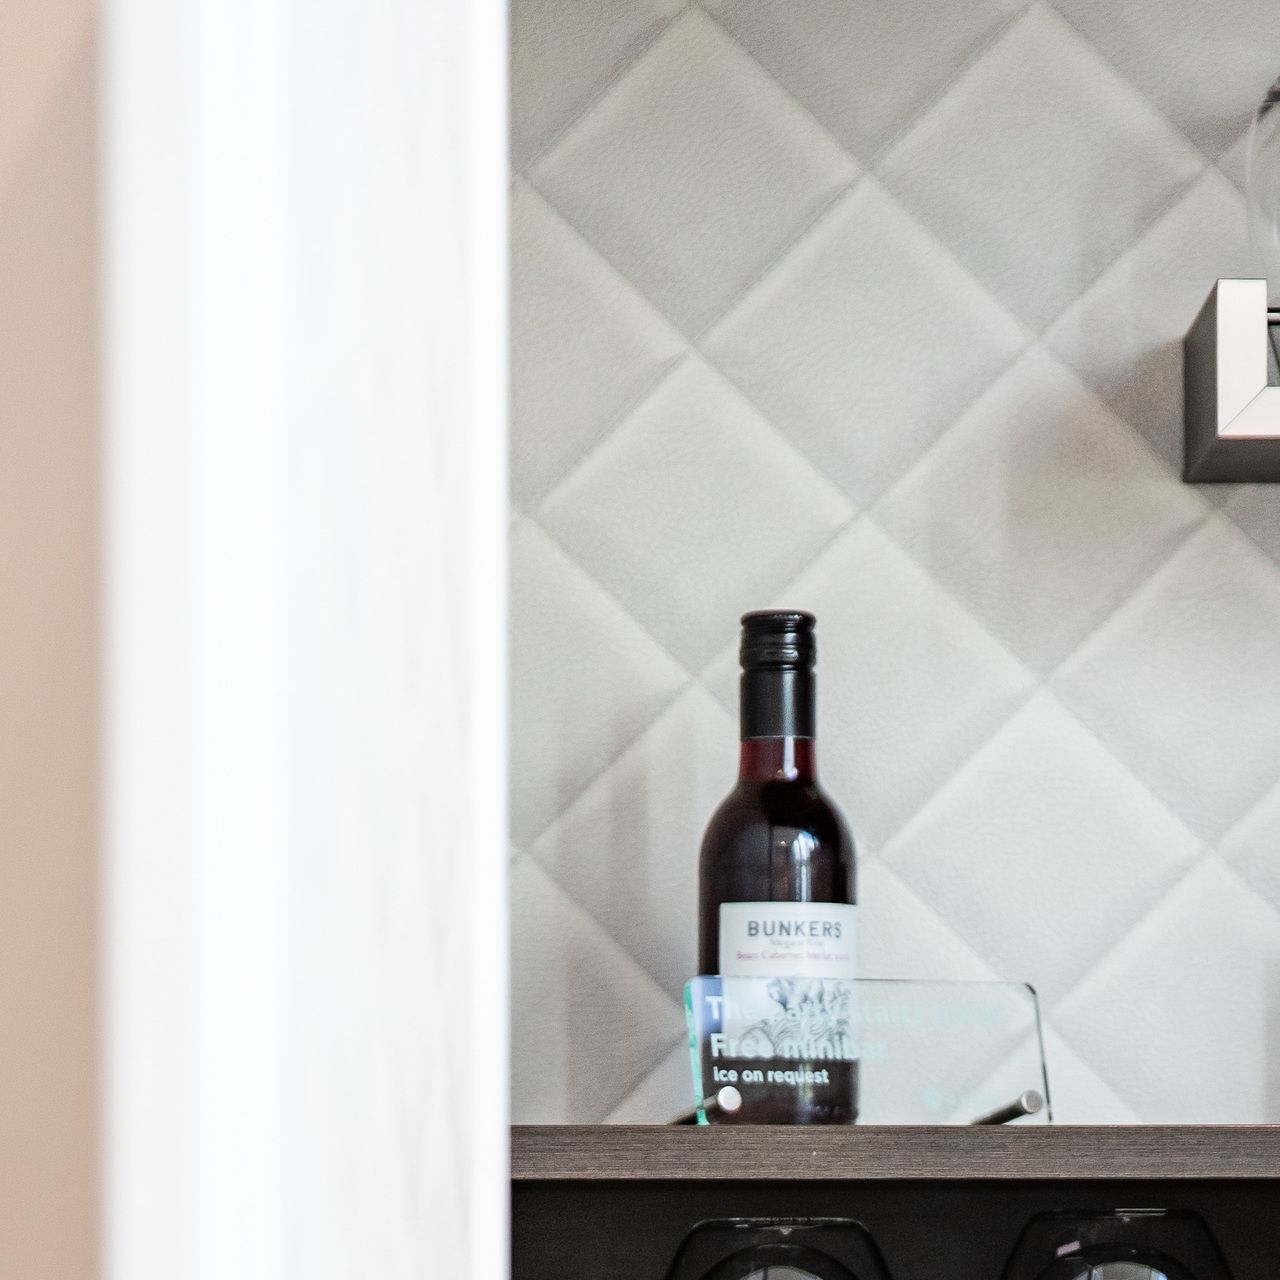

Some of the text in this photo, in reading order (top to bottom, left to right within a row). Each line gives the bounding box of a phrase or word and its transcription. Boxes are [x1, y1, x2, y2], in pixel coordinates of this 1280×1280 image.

[747, 920, 842, 939] BUNKERS
[710, 1033, 775, 1058] Free
[742, 1068, 763, 1082] on
[767, 1069, 829, 1085] request
